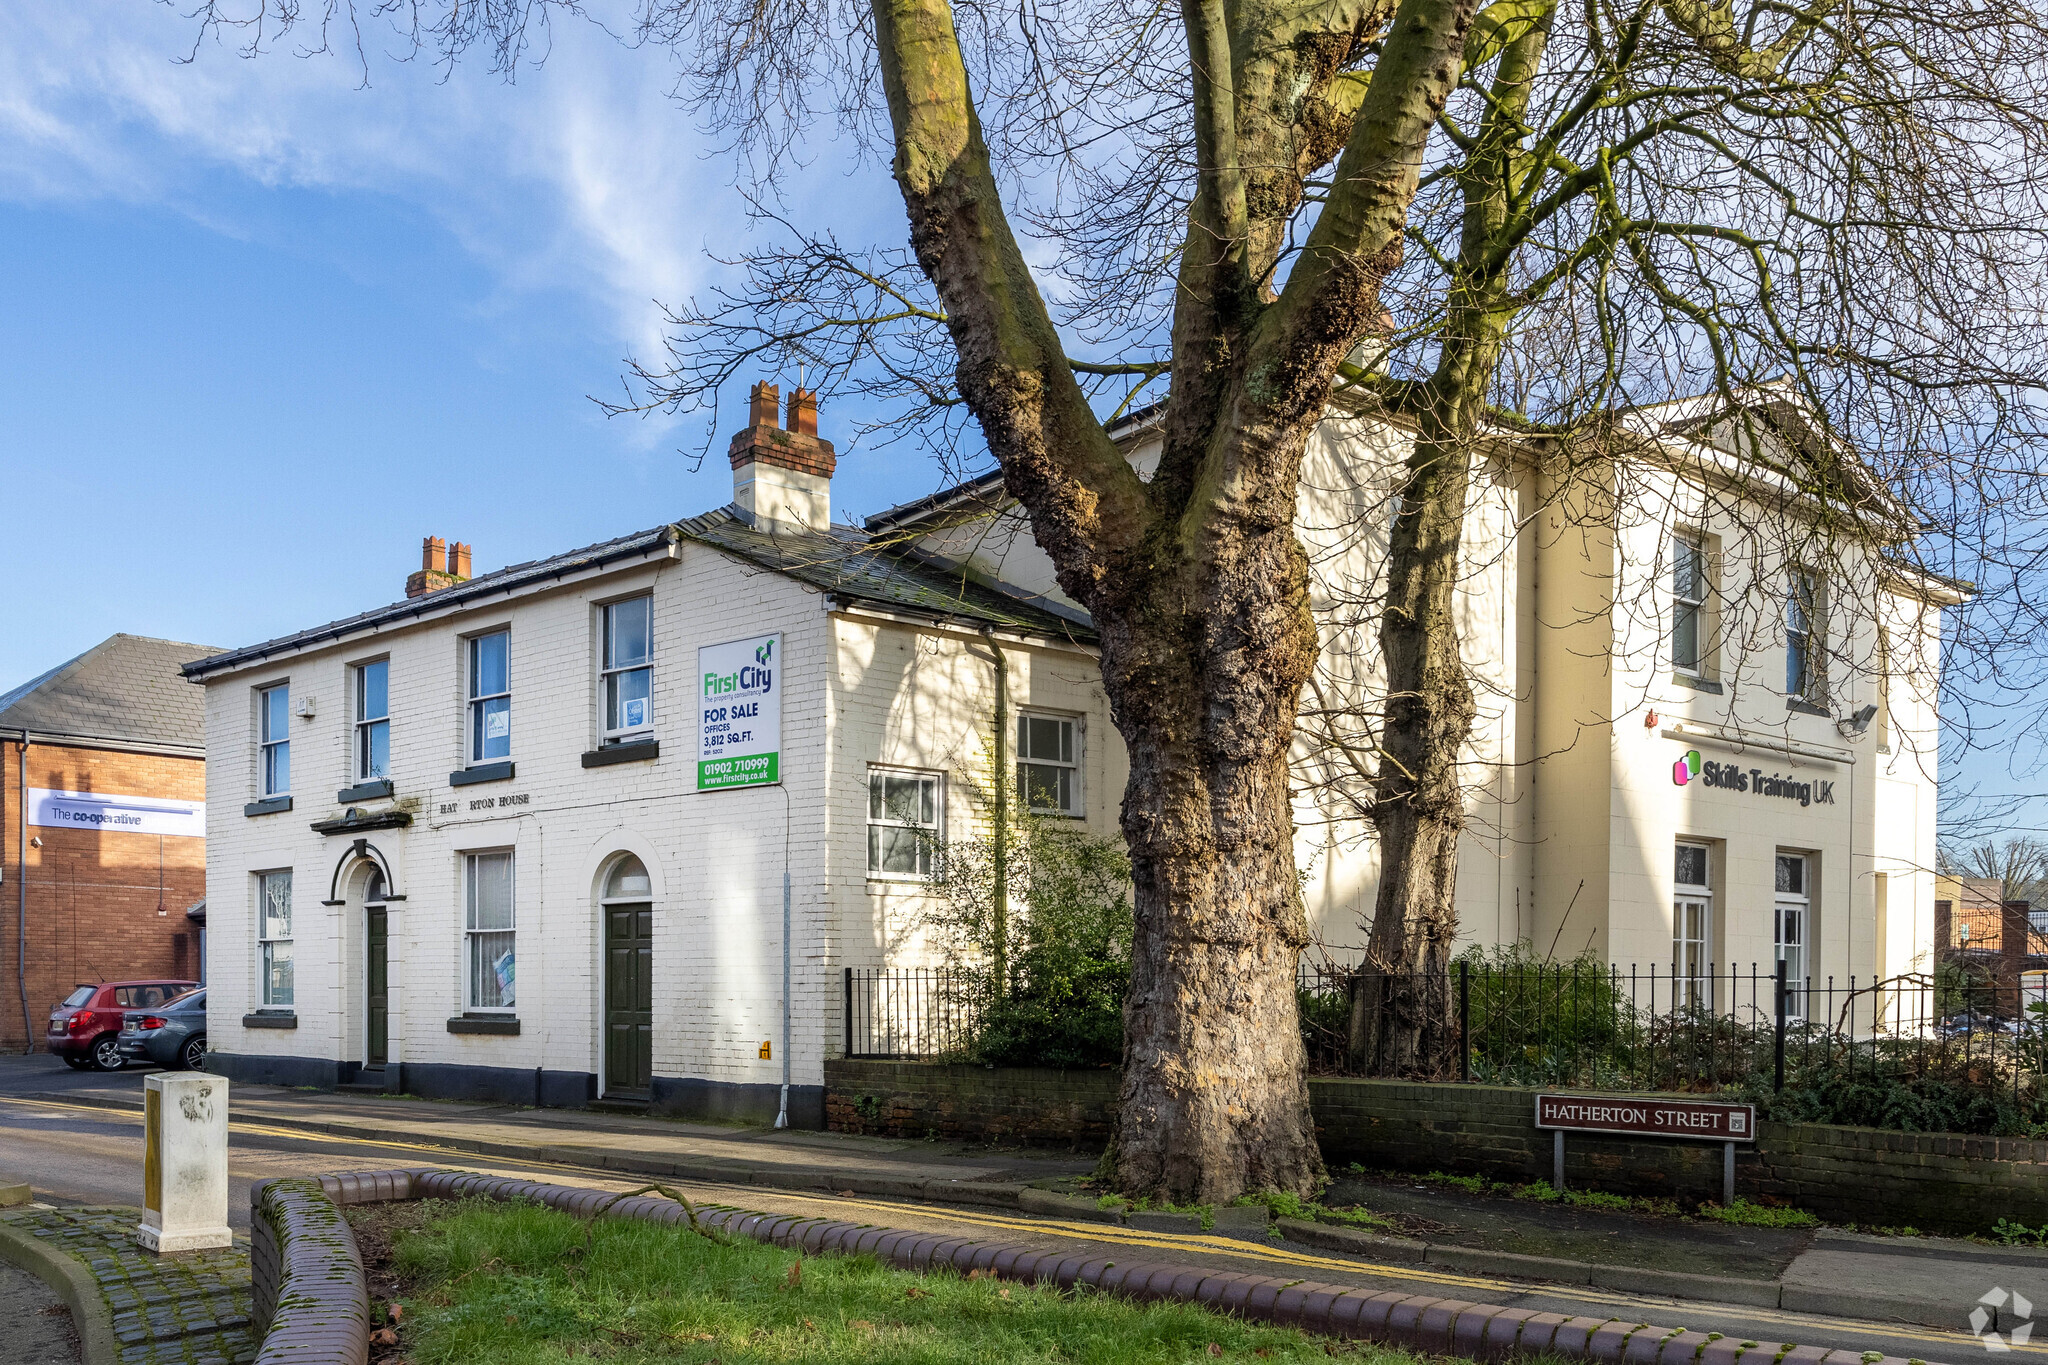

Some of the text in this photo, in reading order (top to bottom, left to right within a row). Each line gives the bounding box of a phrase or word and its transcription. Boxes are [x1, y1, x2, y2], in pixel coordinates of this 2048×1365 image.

[713, 693, 734, 703] property
[734, 689, 762, 698] consultancy
[704, 702, 759, 724] FOR SALE
[704, 722, 731, 734] OFFICES
[704, 734, 725, 748] 3,812
[704, 757, 769, 776] 01902 710999
[704, 770, 768, 785] www.firstcity.co.uk
[1703, 760, 1835, 807] Skills Training UK
[498, 793, 530, 807] HOUSE
[52, 807, 142, 826] The co-operative
[1544, 1104, 1722, 1128] HATHERTON STREET
